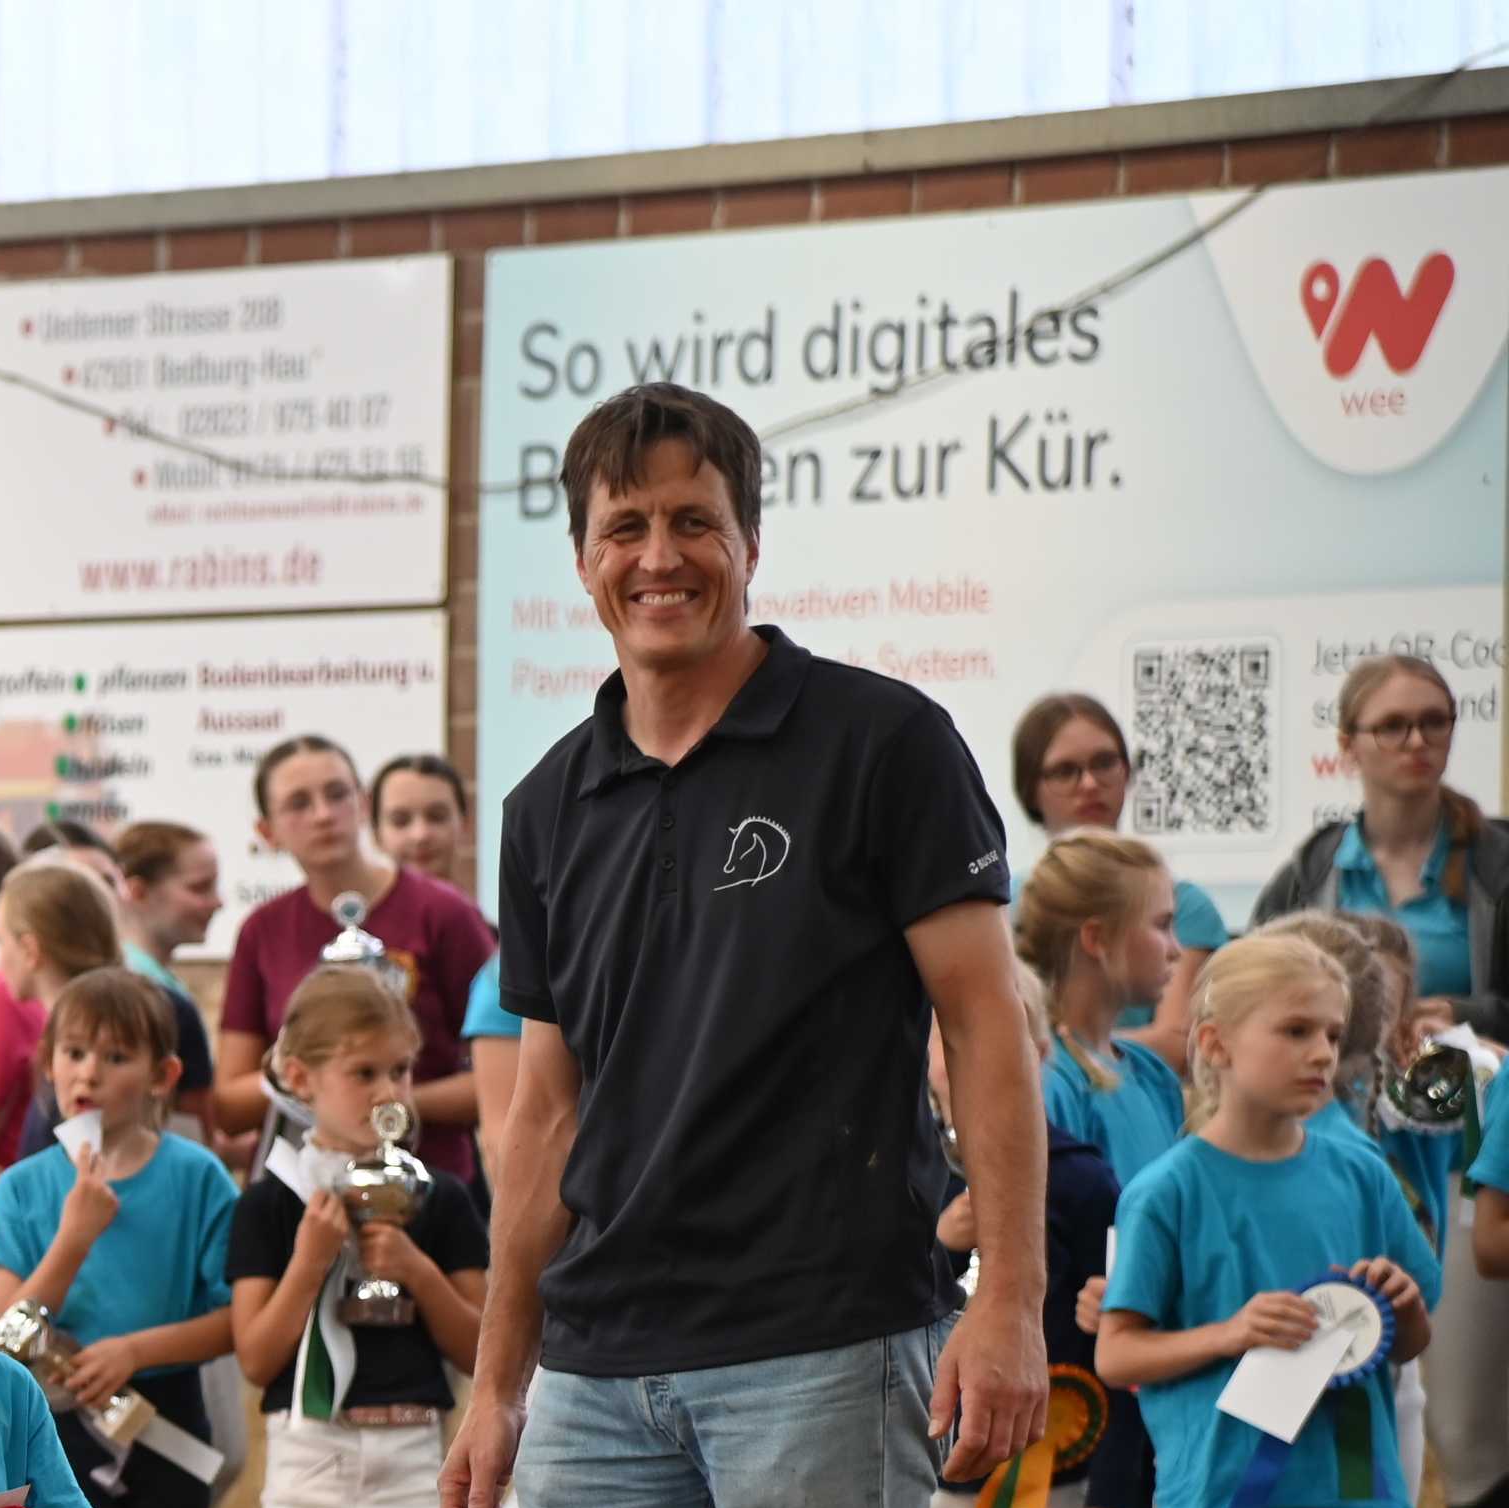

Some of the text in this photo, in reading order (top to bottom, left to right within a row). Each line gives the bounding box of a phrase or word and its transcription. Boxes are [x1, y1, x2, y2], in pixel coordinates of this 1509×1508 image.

[519, 290, 1101, 401] So wird digitales
[1341, 388, 1407, 418] wee
[851, 439, 964, 503] zur
[985, 410, 1123, 493] Kür.
[78, 543, 322, 593] www.rabins.de
[754, 580, 878, 620] ovativen
[889, 573, 993, 615] Mobile
[1456, 682, 1497, 722] nd
